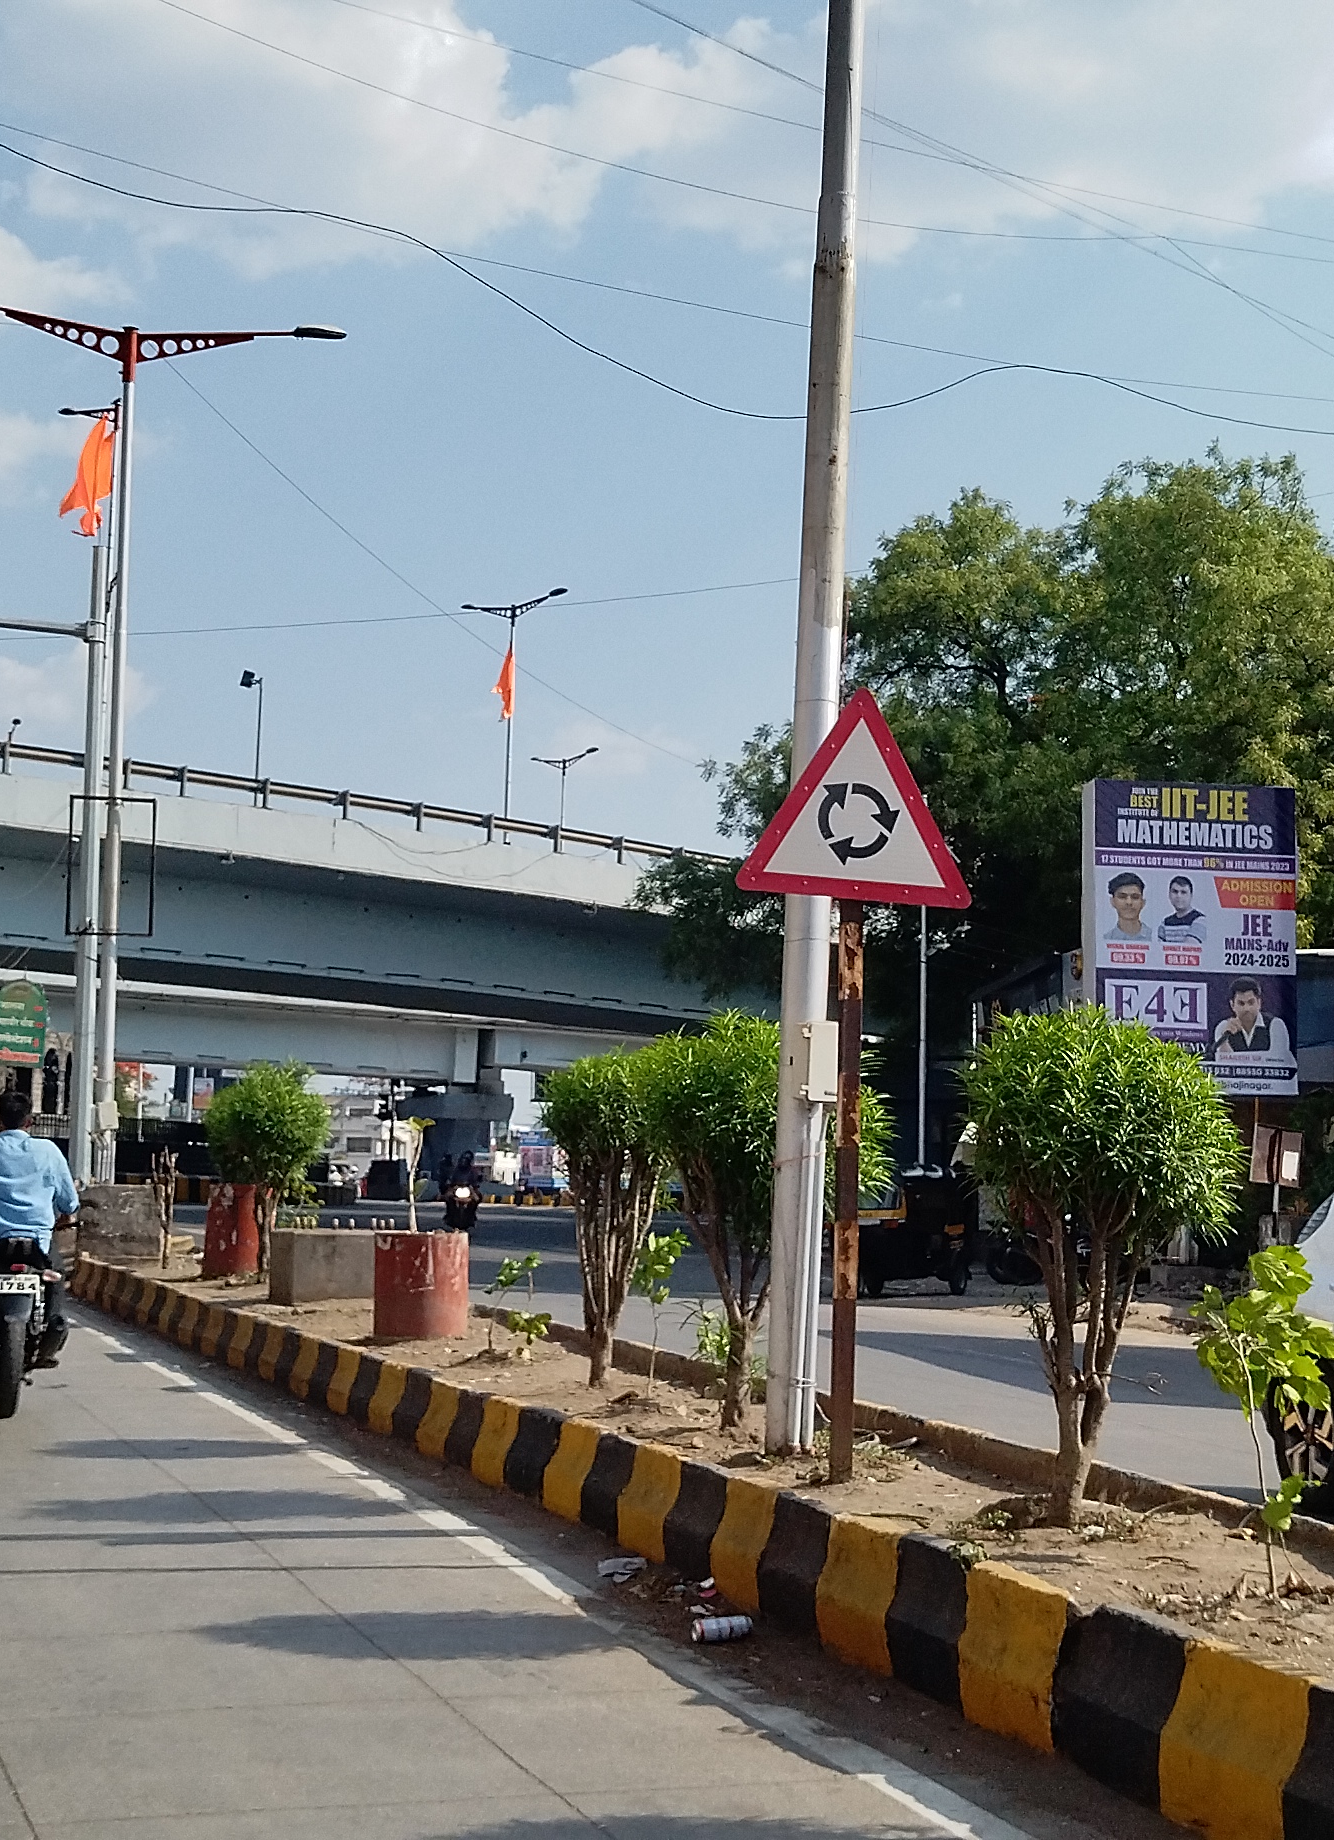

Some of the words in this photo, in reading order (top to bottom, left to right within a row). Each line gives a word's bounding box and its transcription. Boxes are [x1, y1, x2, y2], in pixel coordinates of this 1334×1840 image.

[1130, 794, 1158, 808] BEST
[1161, 787, 1249, 822] IIT-JEE
[1117, 819, 1274, 850] MATHEMATICS
[1109, 855, 1146, 865] STUDENTS
[1221, 879, 1294, 894] ADMISSION
[1239, 894, 1275, 907] OPEN
[1241, 913, 1273, 937] JEE
[1224, 937, 1289, 953] MAINS-Adv
[1224, 952, 1290, 968] 2024-2025
[0, 1281, 36, 1292] 1784
